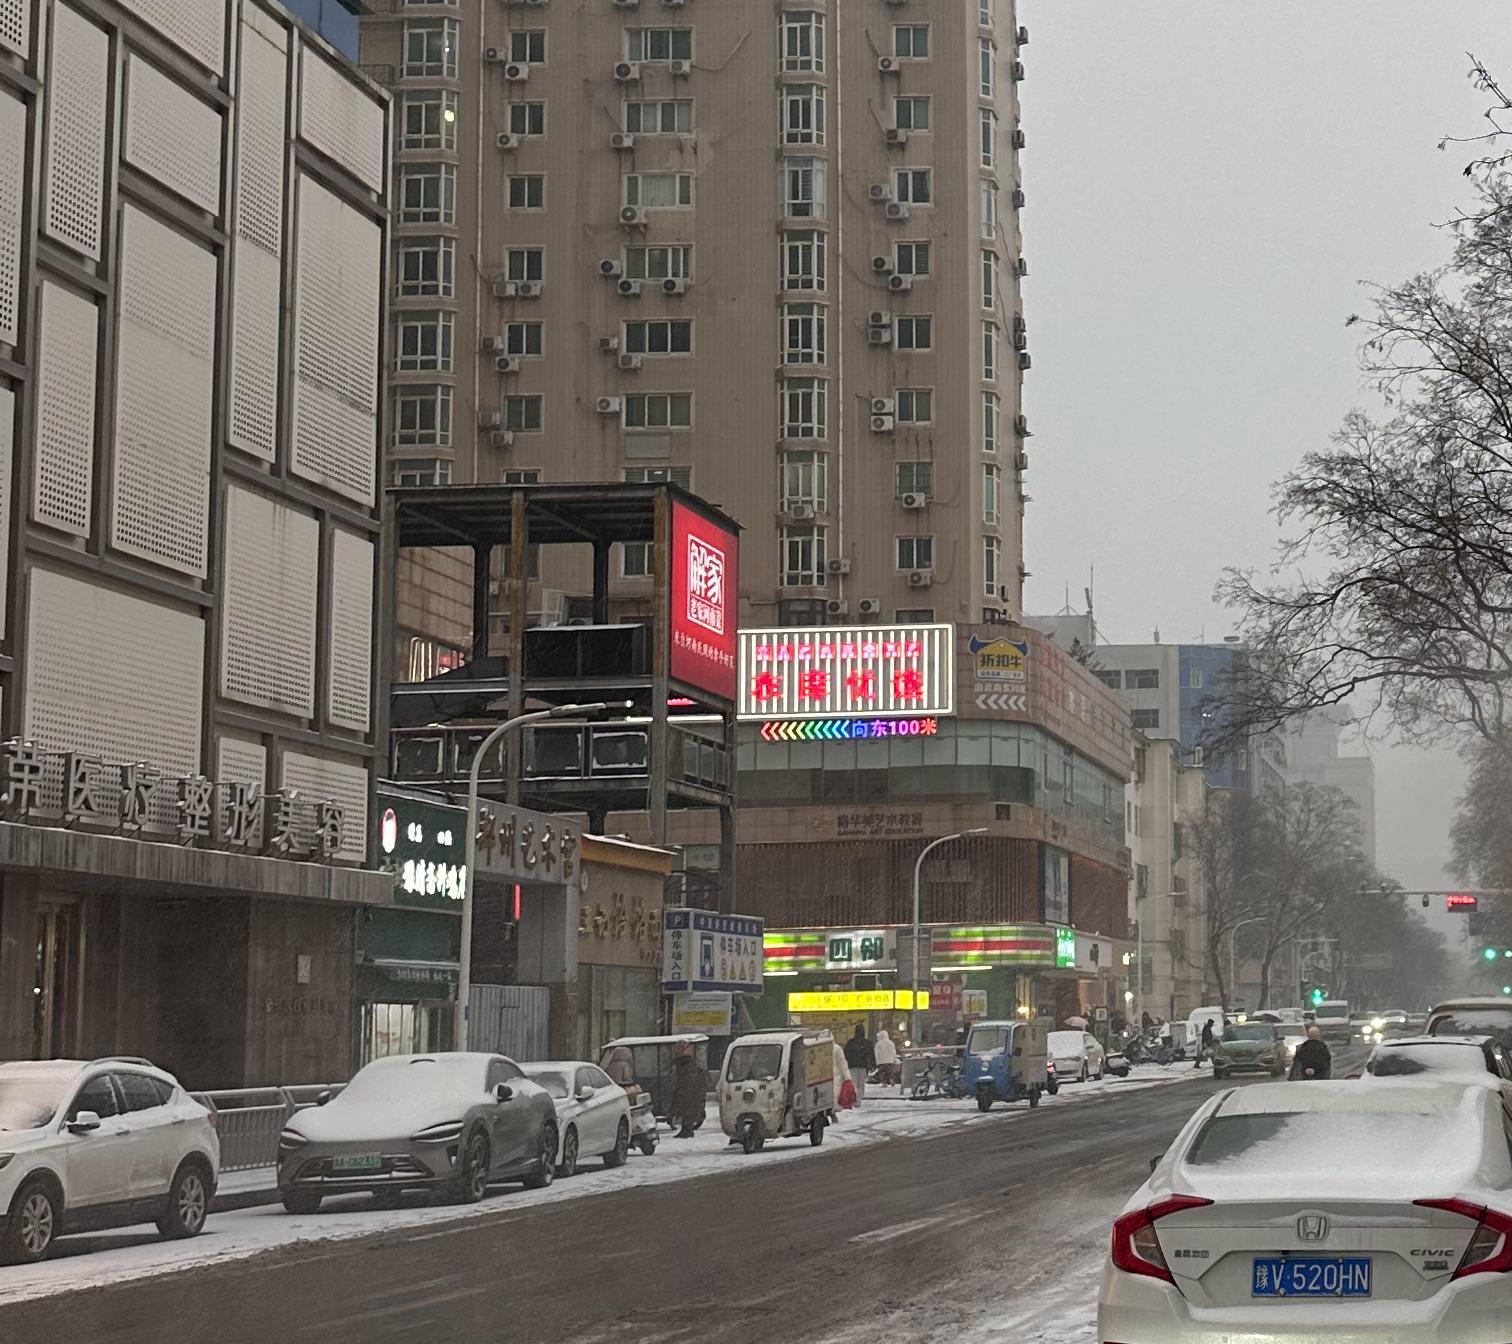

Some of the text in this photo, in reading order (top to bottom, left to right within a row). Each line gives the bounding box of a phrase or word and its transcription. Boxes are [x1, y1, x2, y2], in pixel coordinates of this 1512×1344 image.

[852, 718, 937, 737] 向东100米
[670, 930, 683, 980] 停车场入口
[1410, 1249, 1455, 1257] CIVIC
